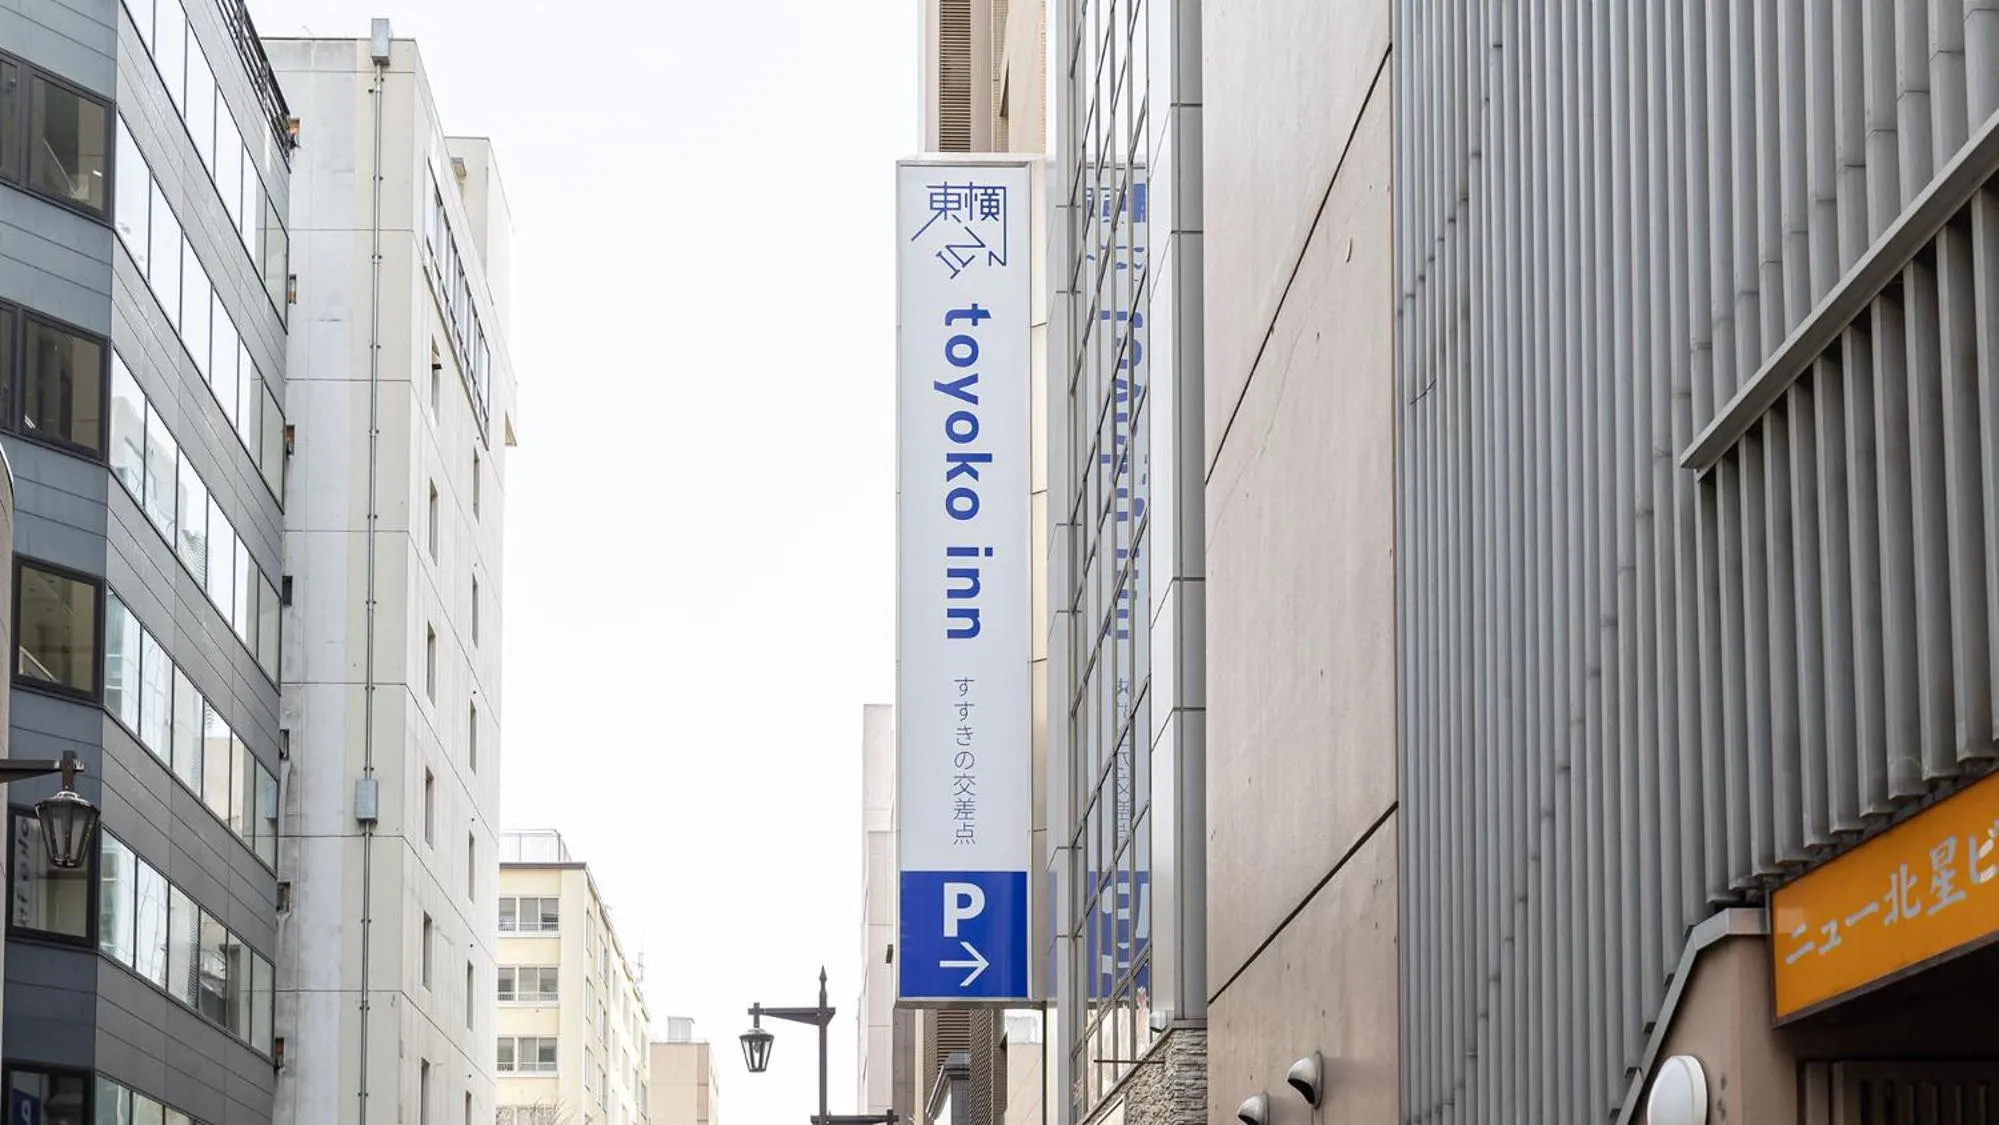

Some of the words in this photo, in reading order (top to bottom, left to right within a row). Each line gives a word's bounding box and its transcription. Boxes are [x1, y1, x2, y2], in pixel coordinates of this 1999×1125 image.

[934, 303, 993, 521] toyoko
[946, 546, 993, 639] inn
[953, 676, 976, 845] すすきの交差点
[943, 882, 985, 937] P
